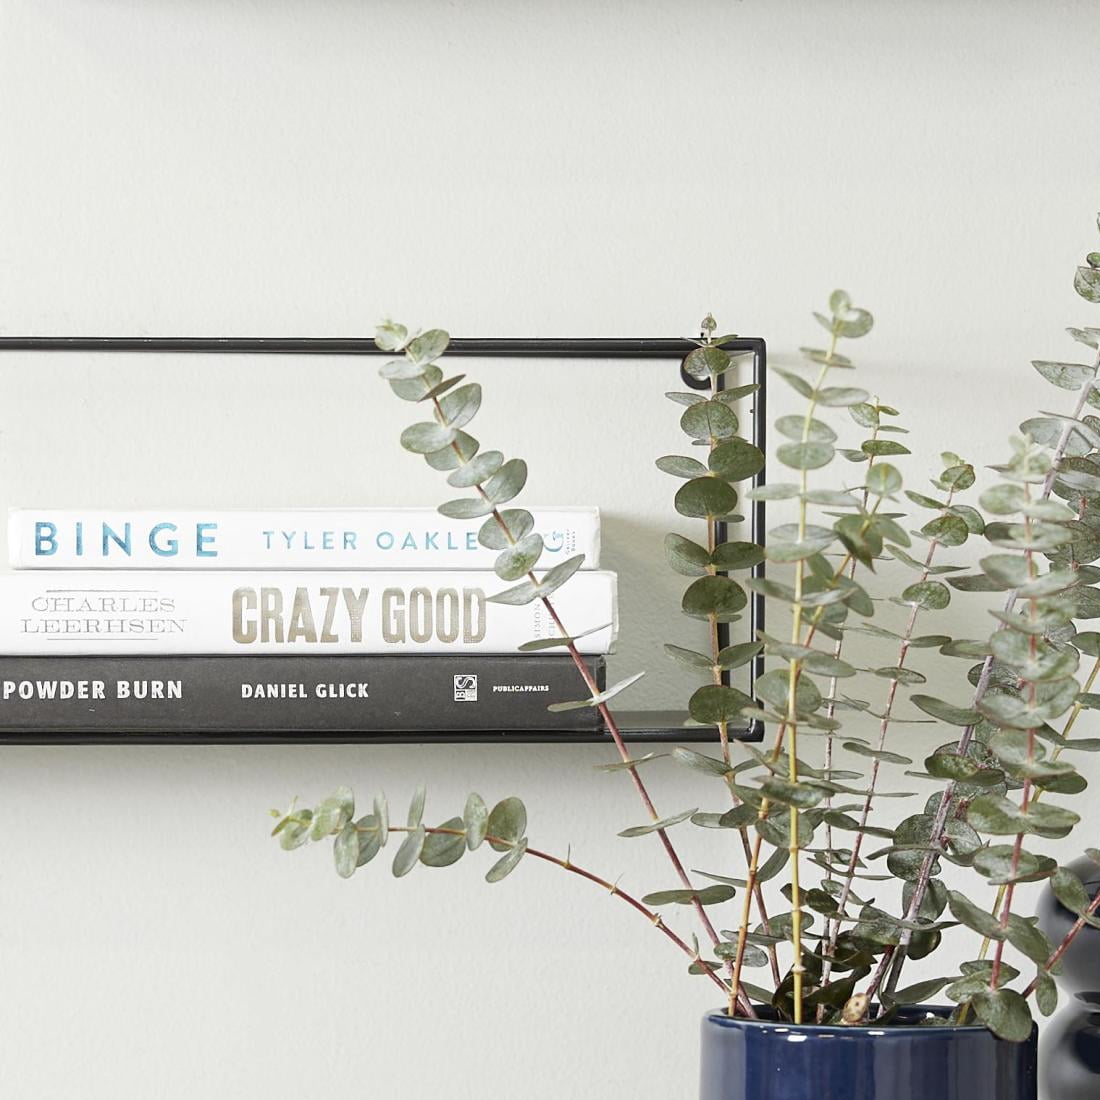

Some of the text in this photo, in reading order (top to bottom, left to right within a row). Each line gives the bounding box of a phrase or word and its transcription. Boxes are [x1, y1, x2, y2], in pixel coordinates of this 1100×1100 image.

[35, 521, 218, 557] BINGE
[262, 531, 479, 550] TYLER OAKLE
[32, 596, 176, 613] CHARLES
[232, 586, 370, 644] CRAZY
[381, 586, 487, 644] GOOD
[20, 618, 188, 634] LEERHSEN
[3, 680, 182, 699] POWDER BURN
[241, 684, 369, 698] DANIEL GLICK
[492, 685, 549, 693] PUBLICAFFAIRS
